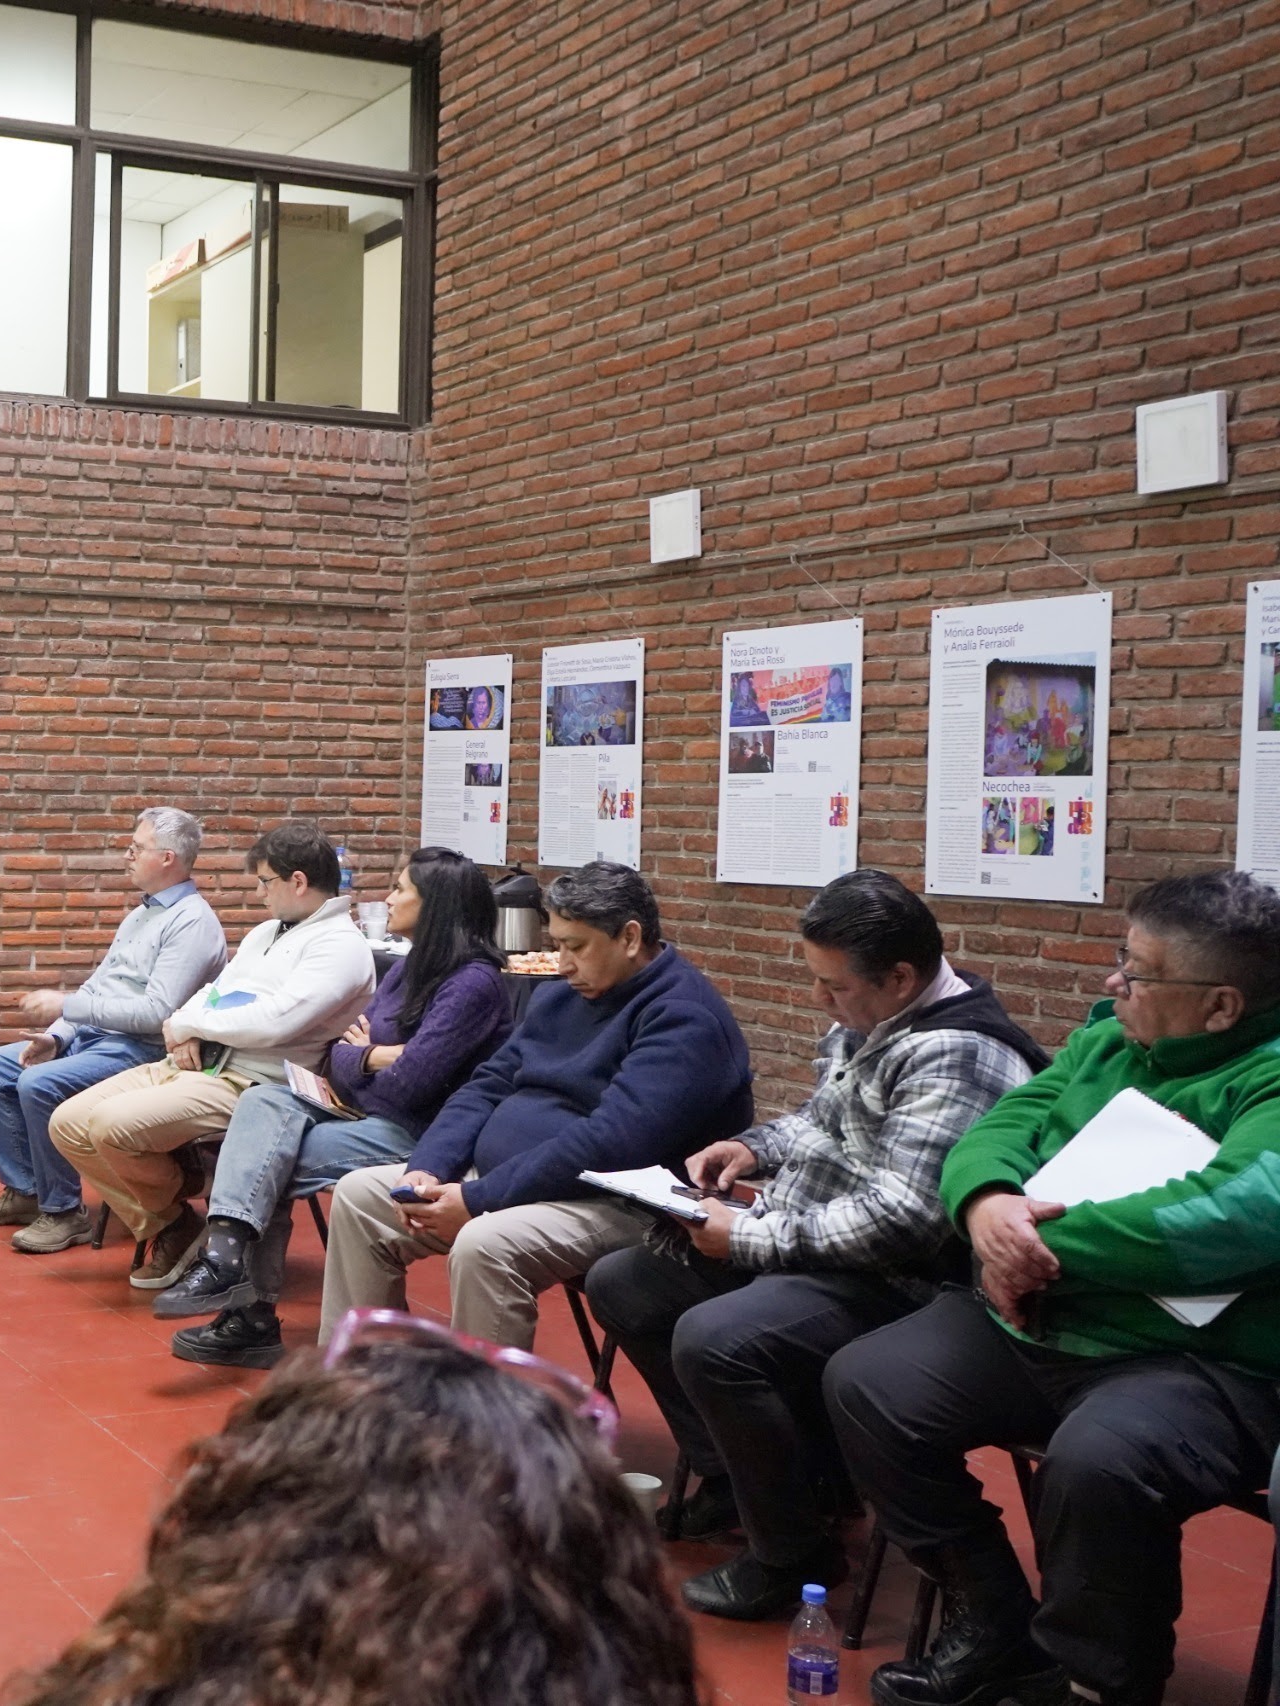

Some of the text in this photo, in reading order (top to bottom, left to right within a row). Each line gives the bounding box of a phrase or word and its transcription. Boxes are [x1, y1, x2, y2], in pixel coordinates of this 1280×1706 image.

[944, 622, 1024, 638] Mónica Bouyssede
[943, 644, 949, 654] y
[979, 636, 1015, 649] Ferraioli
[730, 648, 748, 658] Nora
[752, 657, 765, 666] Eva
[766, 656, 785, 665] Rossi
[771, 709, 778, 717] ES
[779, 705, 803, 716] JUSTICIA
[777, 729, 828, 741] Bahía Blanca
[465, 740, 486, 749] General
[465, 749, 488, 759] Belgrano
[982, 780, 1031, 793] Necochea
